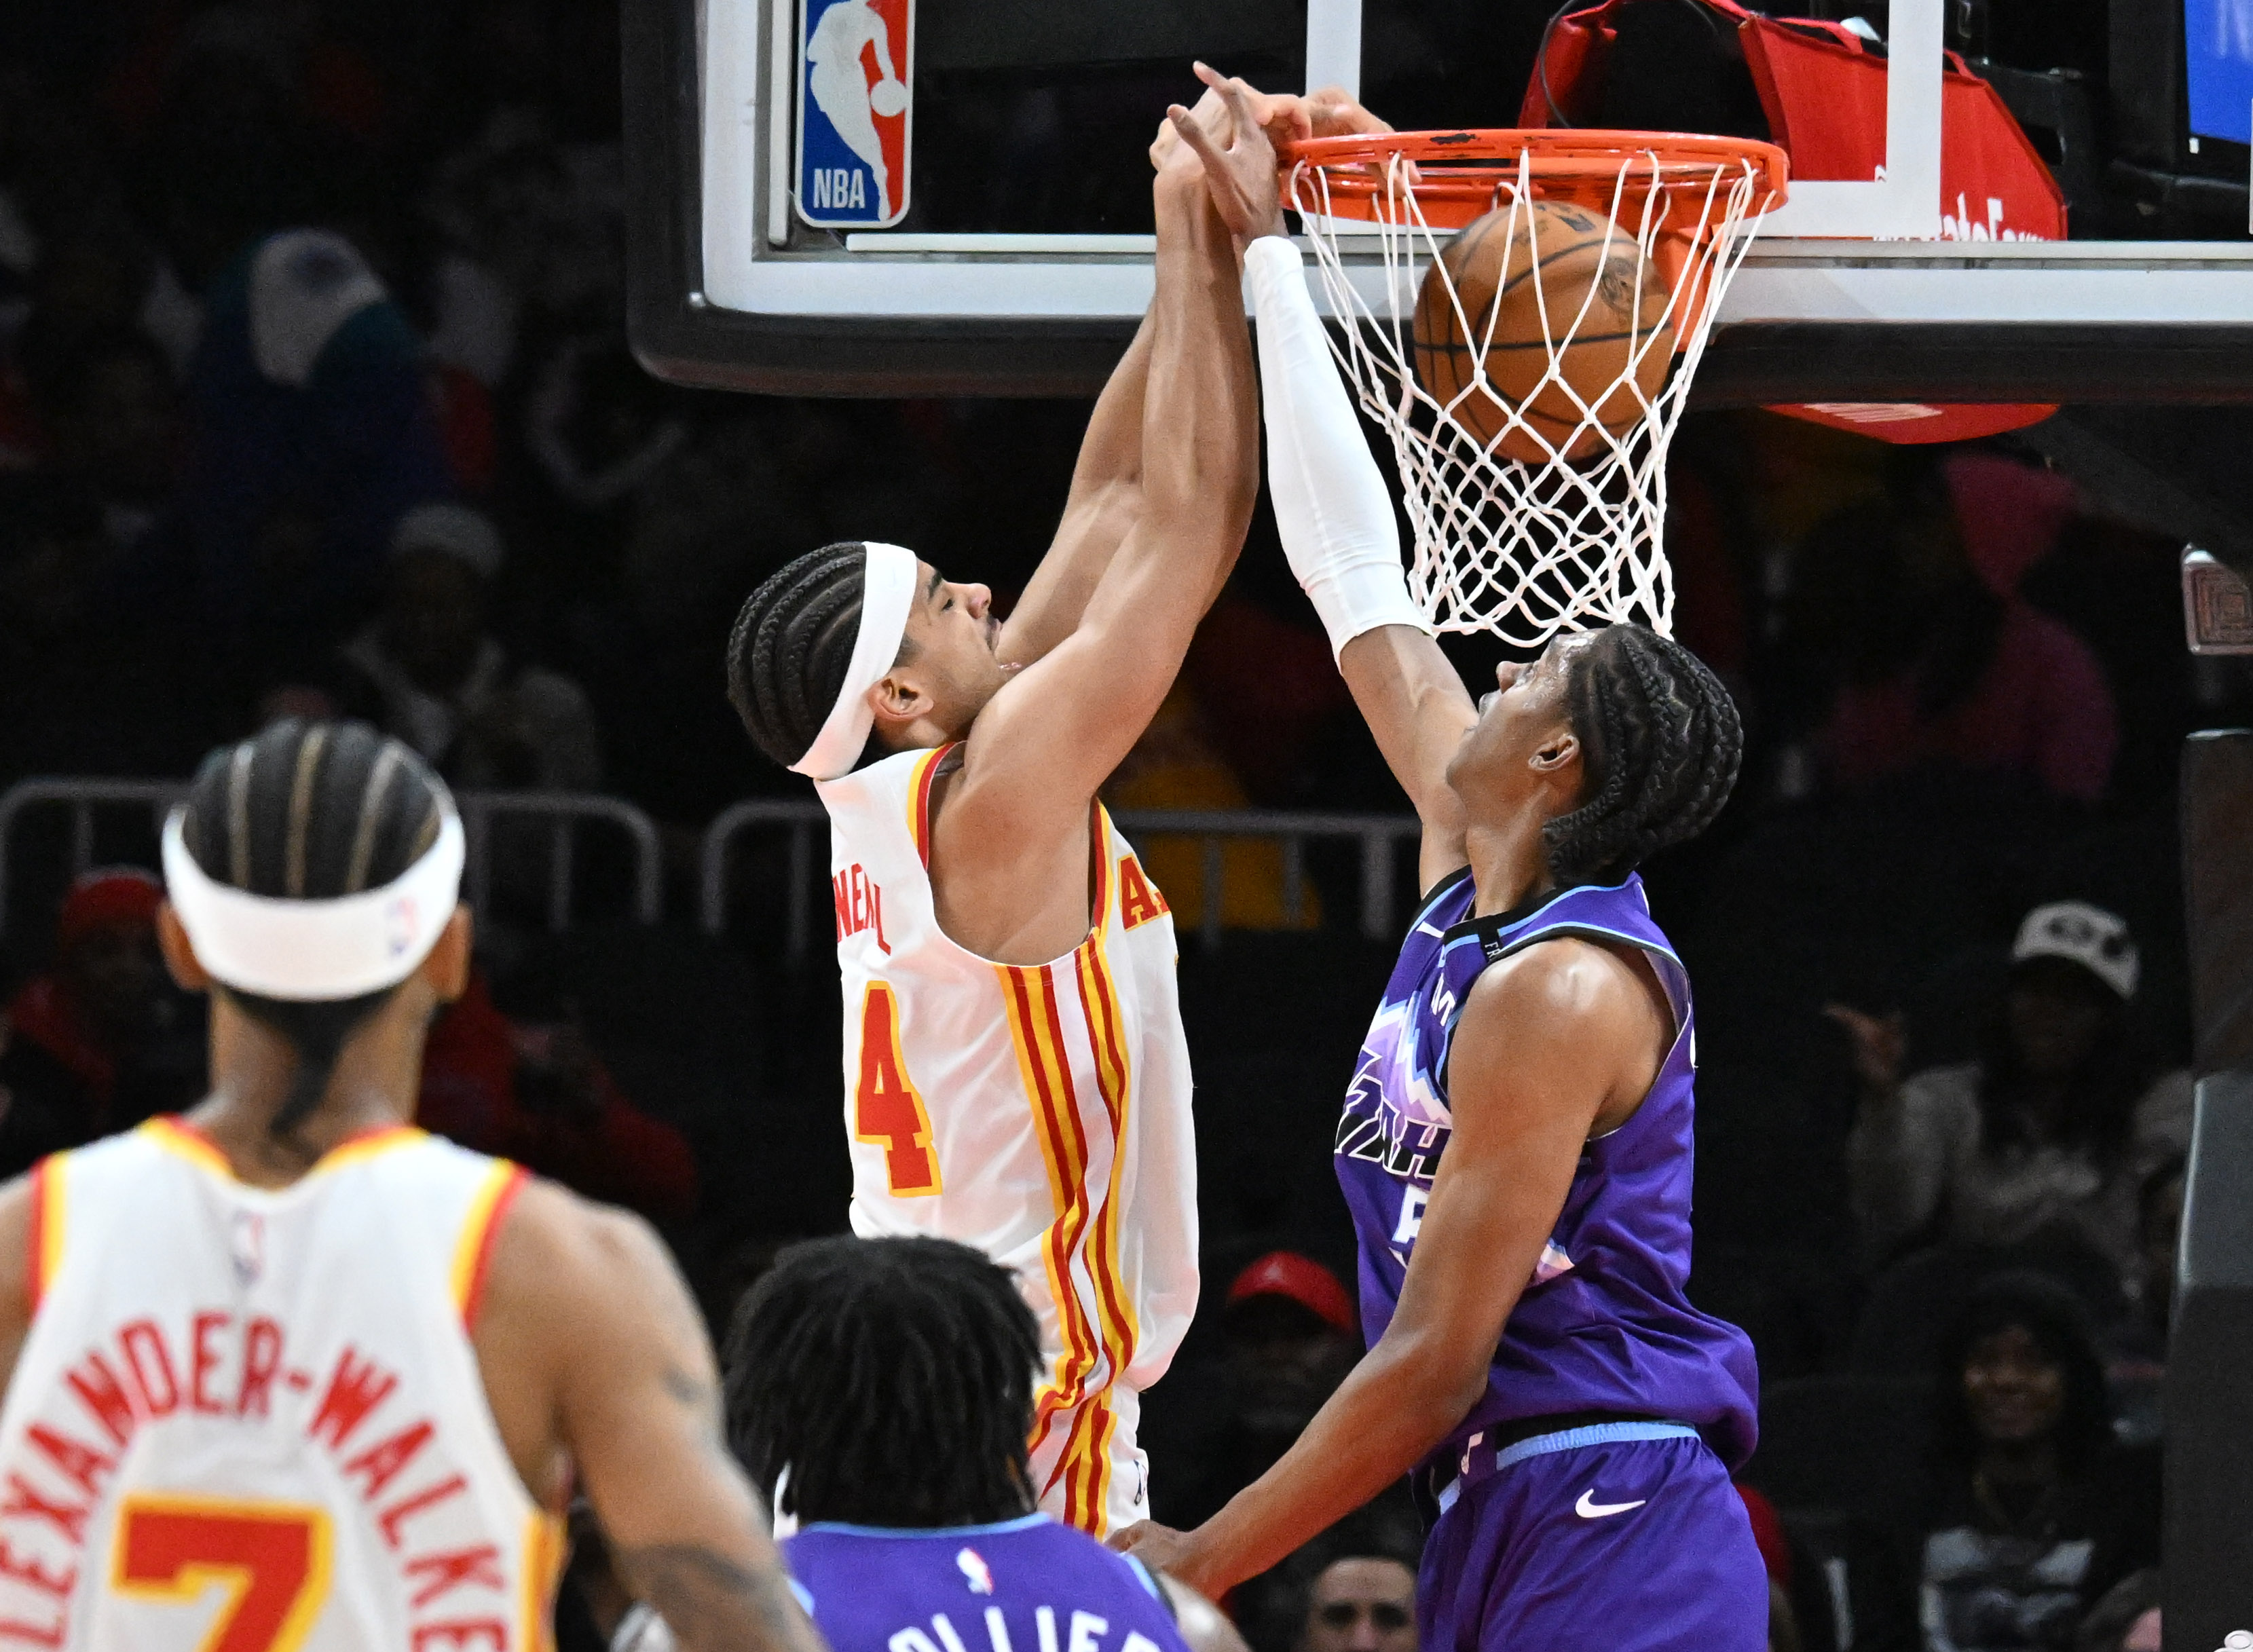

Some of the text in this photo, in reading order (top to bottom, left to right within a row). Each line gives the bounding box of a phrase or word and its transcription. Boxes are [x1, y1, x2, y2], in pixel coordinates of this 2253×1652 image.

[813, 168, 865, 209] NBA
[855, 980, 942, 1197] 4
[112, 1493, 333, 1652] 7
